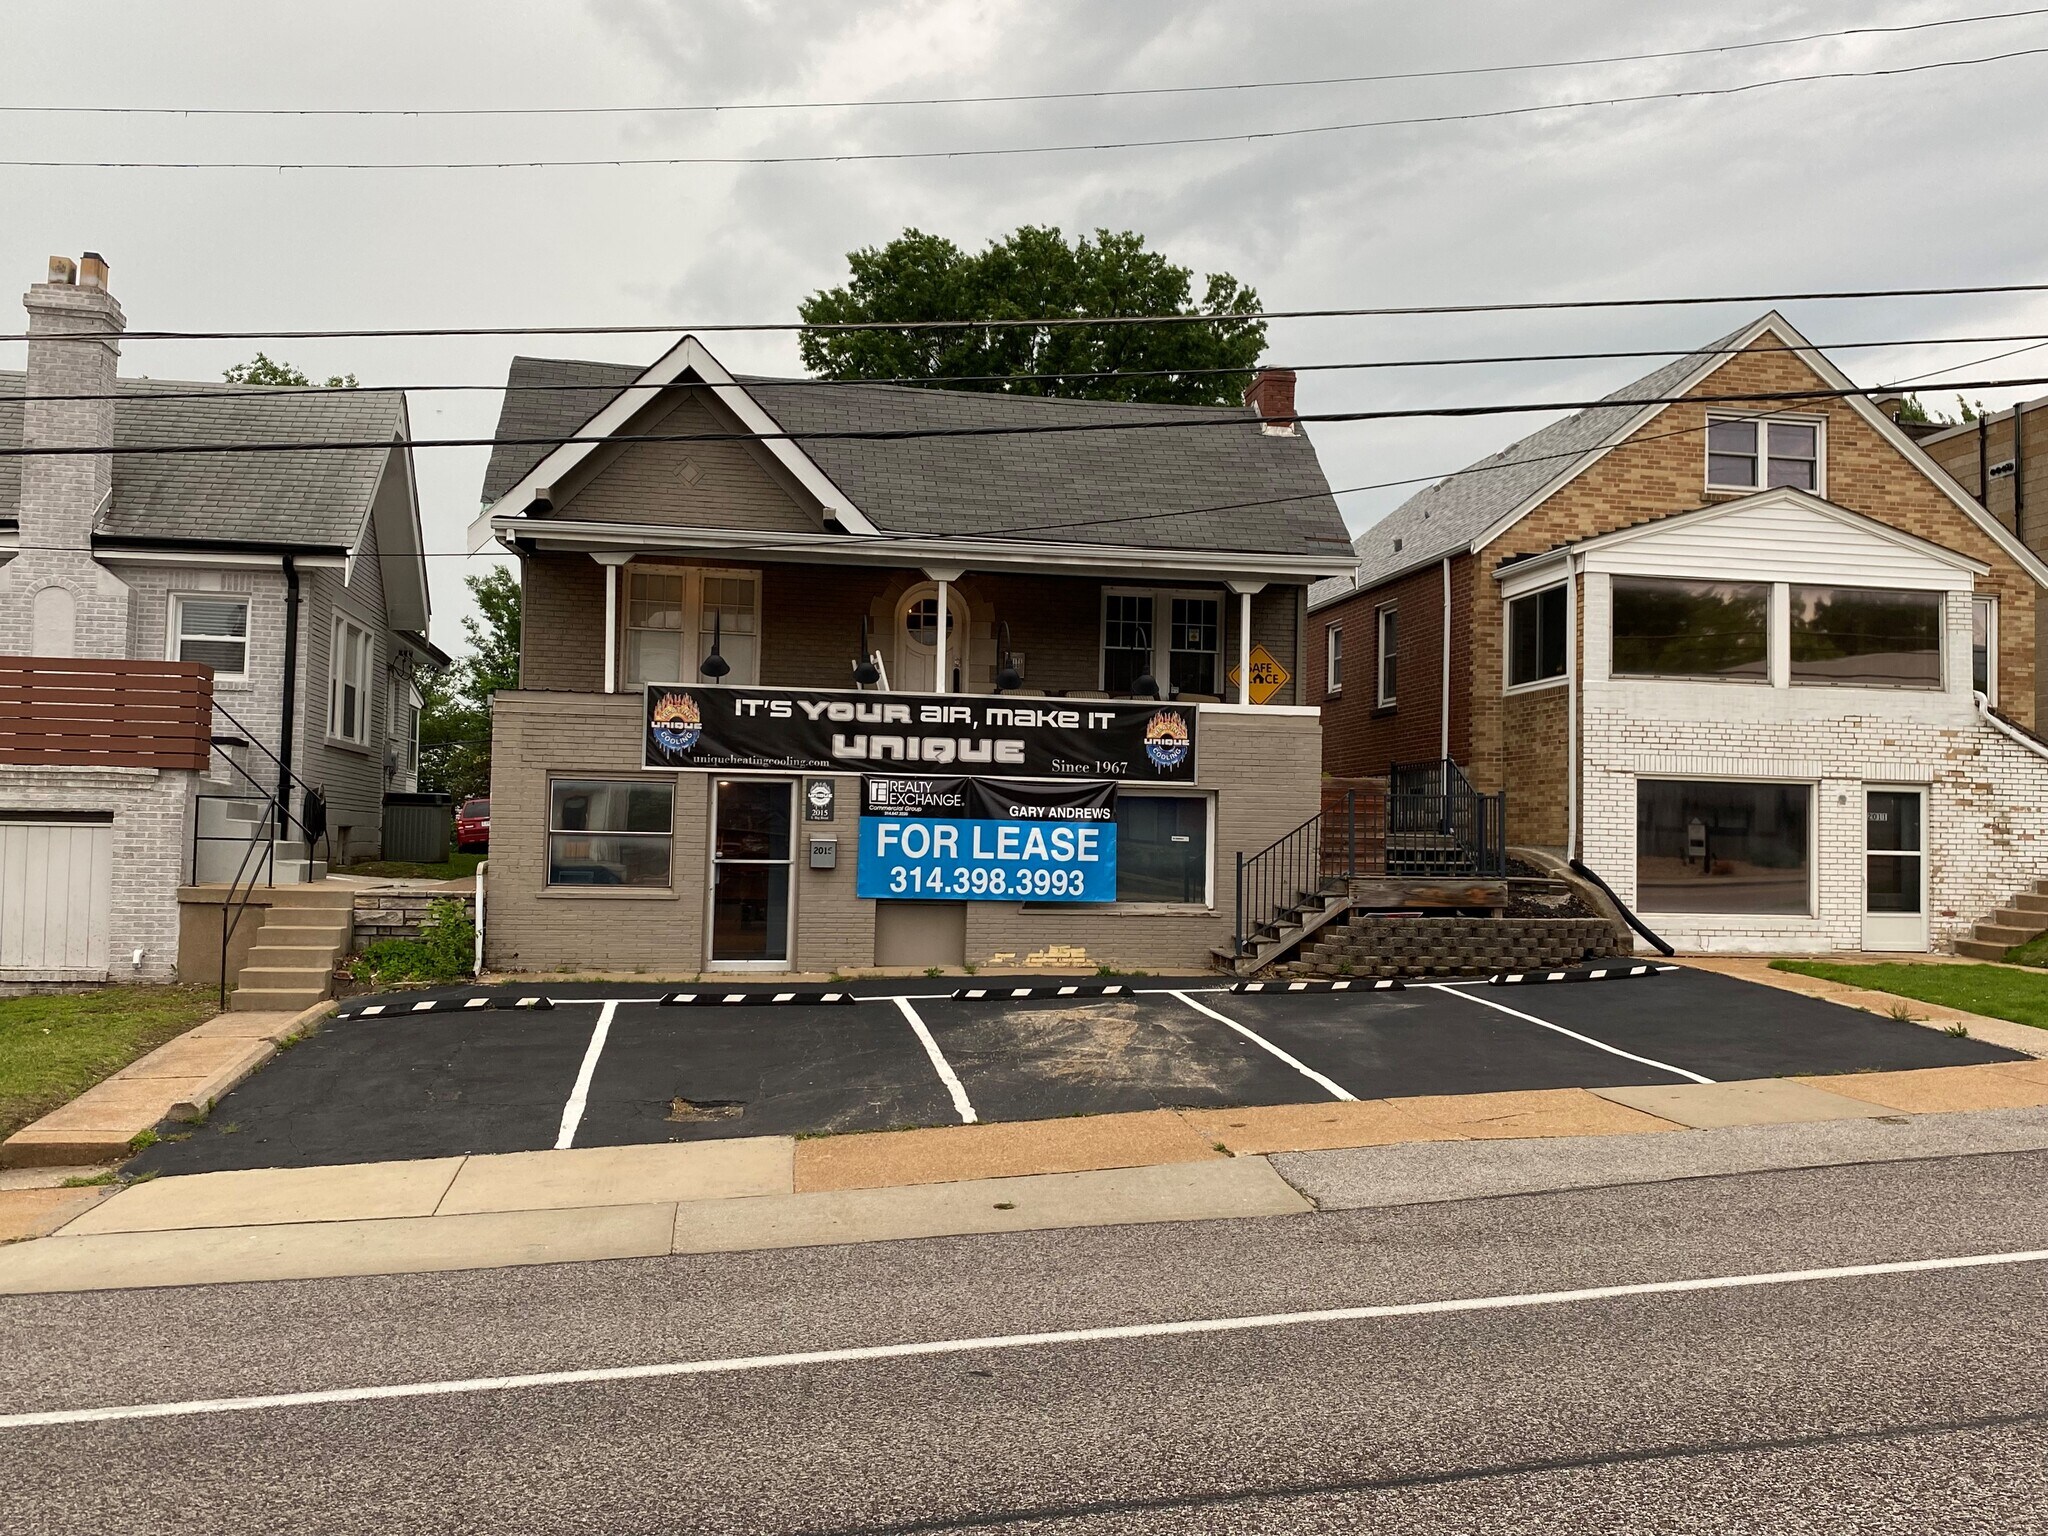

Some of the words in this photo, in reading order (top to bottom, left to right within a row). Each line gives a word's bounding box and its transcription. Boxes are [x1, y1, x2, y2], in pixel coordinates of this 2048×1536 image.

[735, 698, 793, 718] IT'S
[796, 700, 913, 724] YOUR
[1088, 711, 1116, 730] IT
[651, 721, 703, 730] UNIQUE
[660, 731, 693, 745] COOLING
[1143, 738, 1190, 746] UNIQUE
[831, 733, 1026, 765] UNIQUE
[1152, 747, 1182, 761] COOLING
[693, 753, 830, 768] uniqueheatingcooling.com
[1051, 758, 1090, 773] Since
[1095, 760, 1129, 775] 1967
[889, 780, 933, 794] REALTY
[811, 808, 829, 817] 2015
[868, 804, 903, 812] Commercial
[1009, 805, 1045, 818] GARY
[1048, 806, 1111, 819] ANDREWS
[876, 823, 959, 859] FOR
[973, 825, 1099, 862] LEASE
[889, 866, 1085, 896] 314.398.3993
